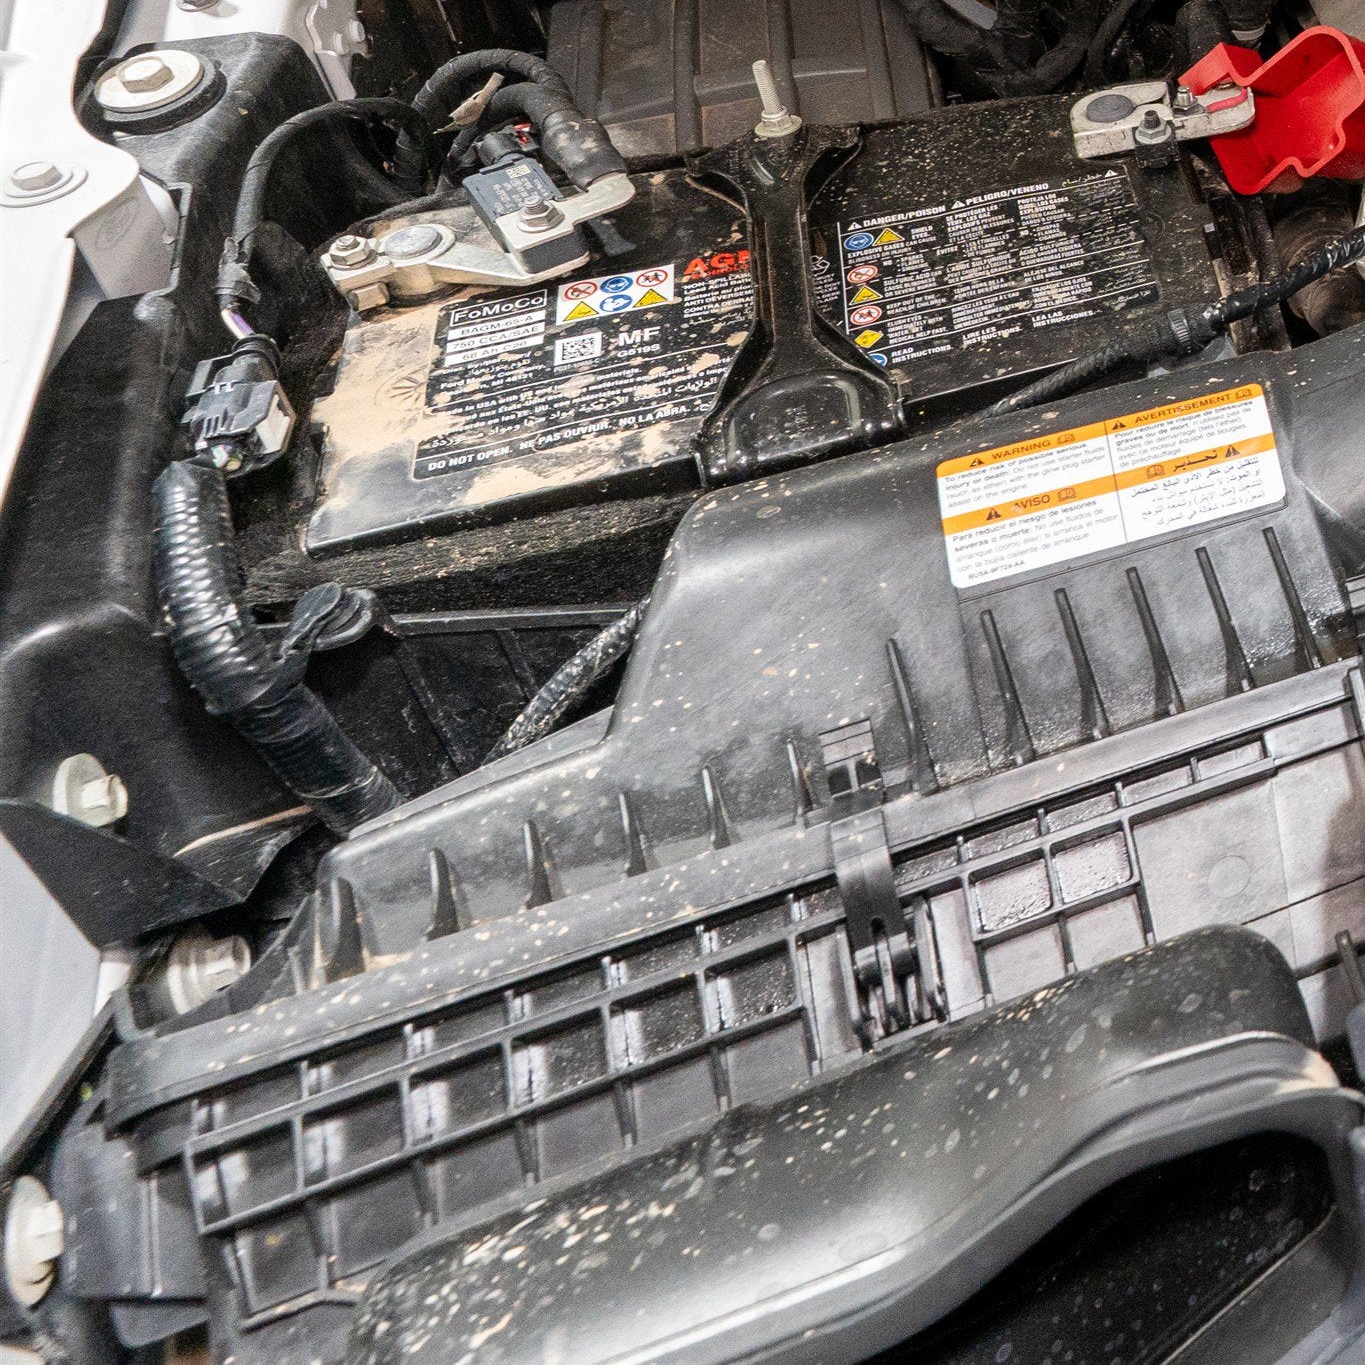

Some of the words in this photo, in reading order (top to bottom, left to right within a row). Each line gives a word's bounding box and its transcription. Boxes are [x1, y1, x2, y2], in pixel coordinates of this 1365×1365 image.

[965, 182, 1048, 206] PELIGRO/VENENO
[863, 204, 945, 227] DANGER/POISON
[454, 293, 543, 322] FoMoCo
[683, 299, 703, 308] ANTI
[683, 301, 720, 315] CONTRA
[460, 314, 533, 336] BAGM-65-A
[1032, 314, 1045, 322] LEA
[1048, 310, 1062, 318] LAS
[1033, 309, 1095, 327] INSTRUCCIONES.
[452, 339, 475, 350] 750
[479, 325, 539, 344] CCA/SAE
[616, 324, 661, 347] MF
[962, 330, 979, 339] LIRE
[982, 326, 996, 334] LES
[462, 351, 477, 360] 68
[482, 346, 498, 355] Ah
[502, 340, 526, 350] C20
[616, 341, 660, 359] G519S
[891, 347, 913, 356] READ
[892, 344, 953, 361] INSTRUCTIONS.
[440, 379, 464, 390] Ford
[466, 372, 495, 384] Motor
[476, 399, 496, 409] USA
[498, 394, 517, 404] with
[596, 365, 642, 381] materials.
[479, 409, 496, 417] aux
[553, 399, 570, 408] con
[1134, 393, 1230, 423] AVERTISSEMENT
[427, 459, 446, 471] DO
[448, 453, 474, 466] NOT
[476, 444, 513, 460] OPEN.
[519, 439, 534, 450] NE
[538, 432, 560, 445] PAS
[563, 420, 612, 438] OUVRIR.
[618, 415, 635, 427] NO
[638, 411, 654, 422] LA
[655, 403, 690, 419] ABRA.
[1115, 434, 1142, 446] graves
[991, 439, 1051, 459] WARNING
[957, 467, 986, 479] reduce
[989, 463, 1004, 471] risk
[1018, 450, 1054, 465] possible
[1173, 450, 1218, 471] تحذير
[1014, 493, 1051, 511] AVISO
[952, 532, 972, 542] Para
[975, 523, 1005, 536] reducir
[1018, 513, 1045, 526] riesgo
[1048, 509, 1059, 517] de
[1060, 499, 1096, 513] lesiones
[953, 538, 988, 552] severas
